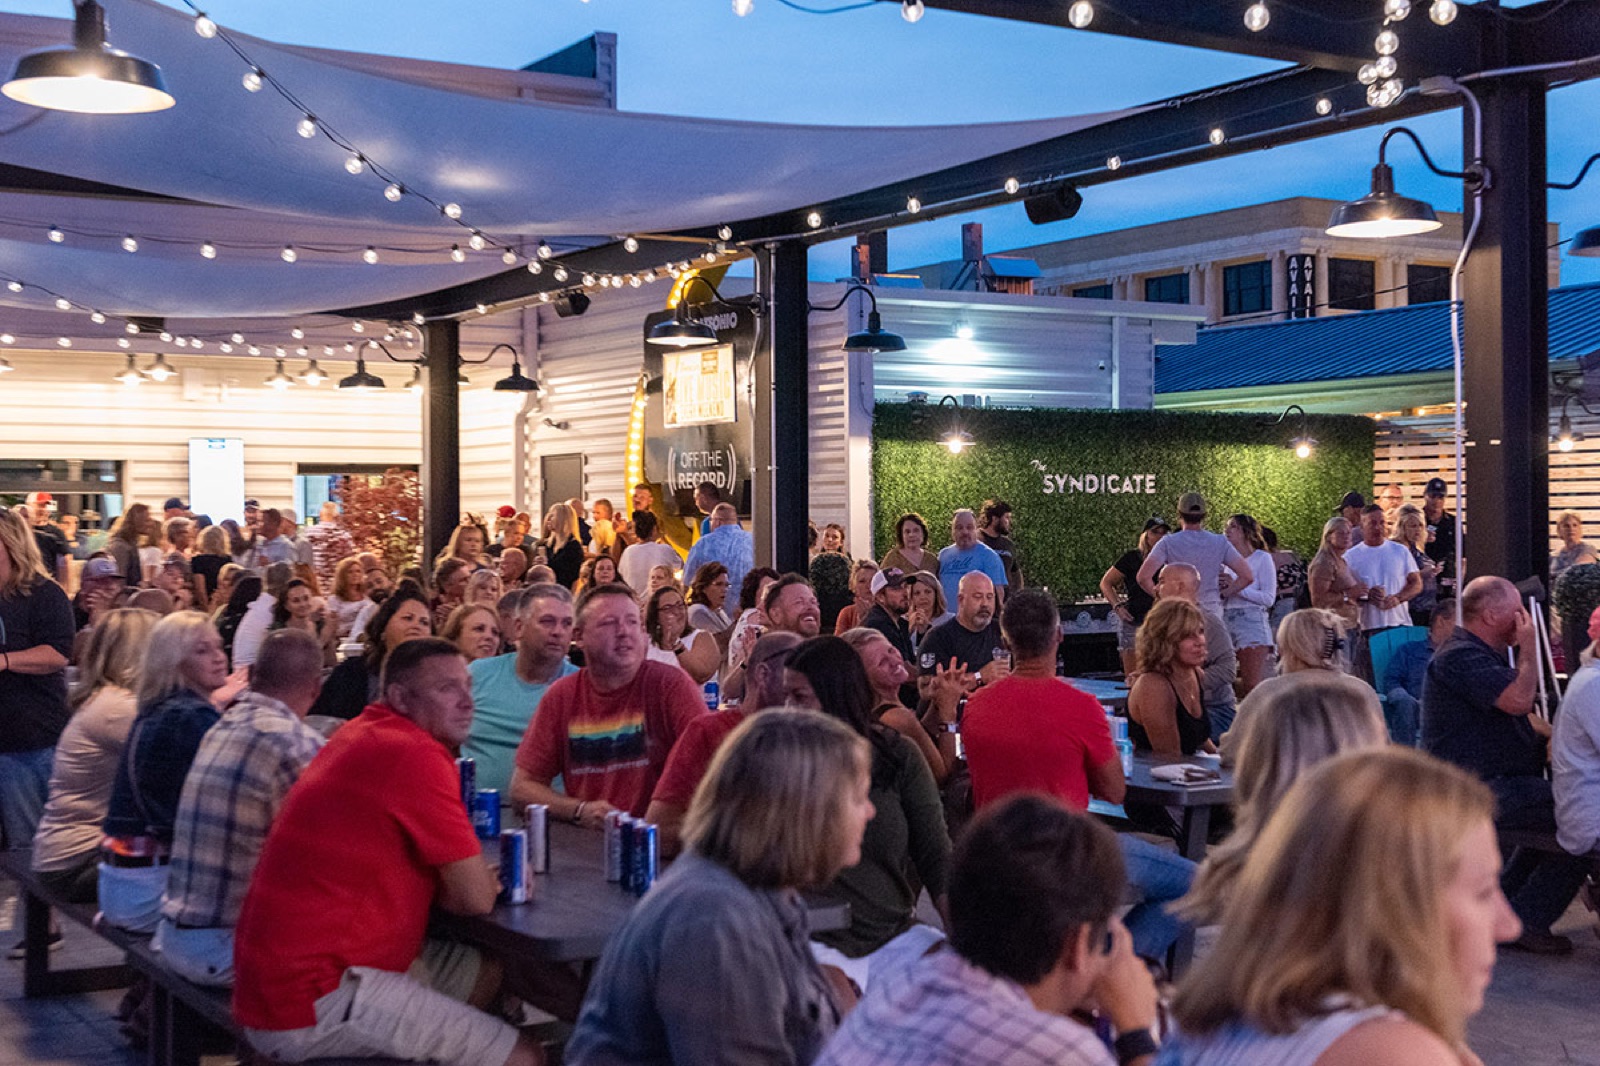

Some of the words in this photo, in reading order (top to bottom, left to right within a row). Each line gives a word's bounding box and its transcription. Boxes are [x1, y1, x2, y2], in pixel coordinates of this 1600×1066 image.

[681, 451, 699, 469] OFF
[700, 450, 722, 467] THE
[678, 471, 726, 489] RECORD
[1042, 473, 1157, 494] SYNDICATE
